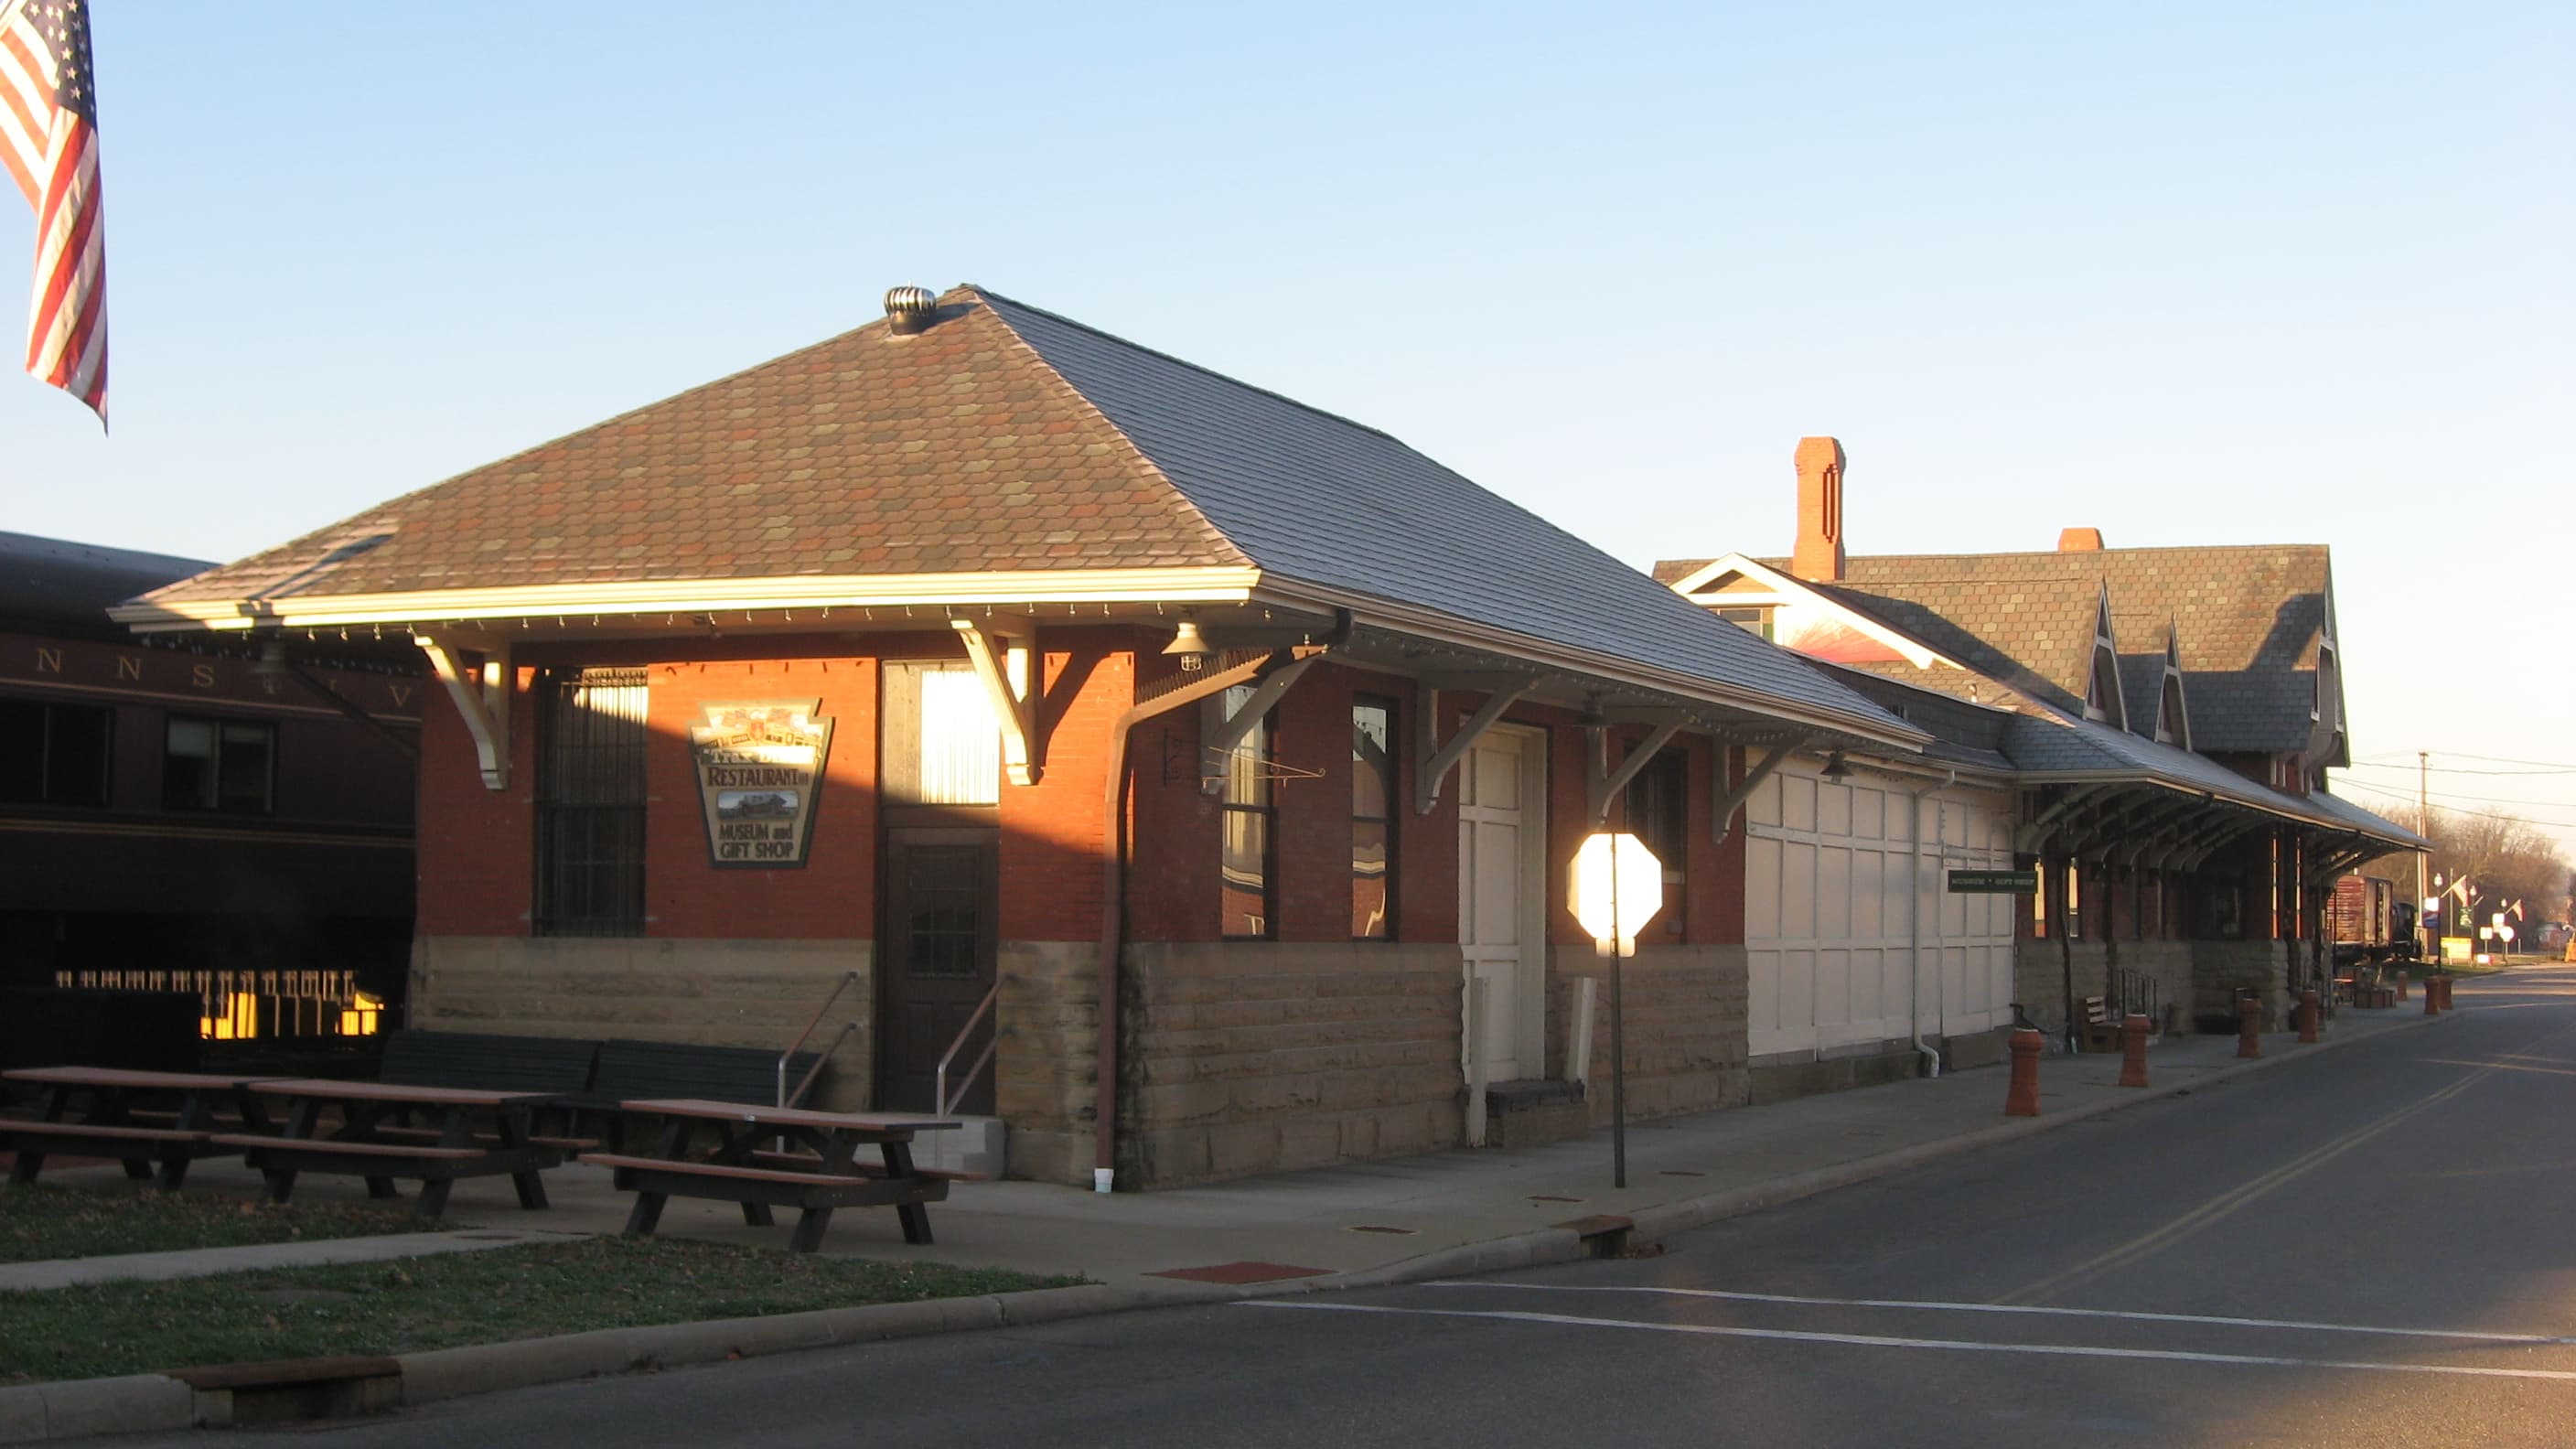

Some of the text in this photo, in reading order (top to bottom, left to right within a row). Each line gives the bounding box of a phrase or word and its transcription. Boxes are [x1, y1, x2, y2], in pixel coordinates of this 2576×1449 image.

[708, 767, 798, 786] RESTAURANT
[719, 822, 793, 840] MUSEUM and
[720, 842, 794, 858] GIFT SHOP
